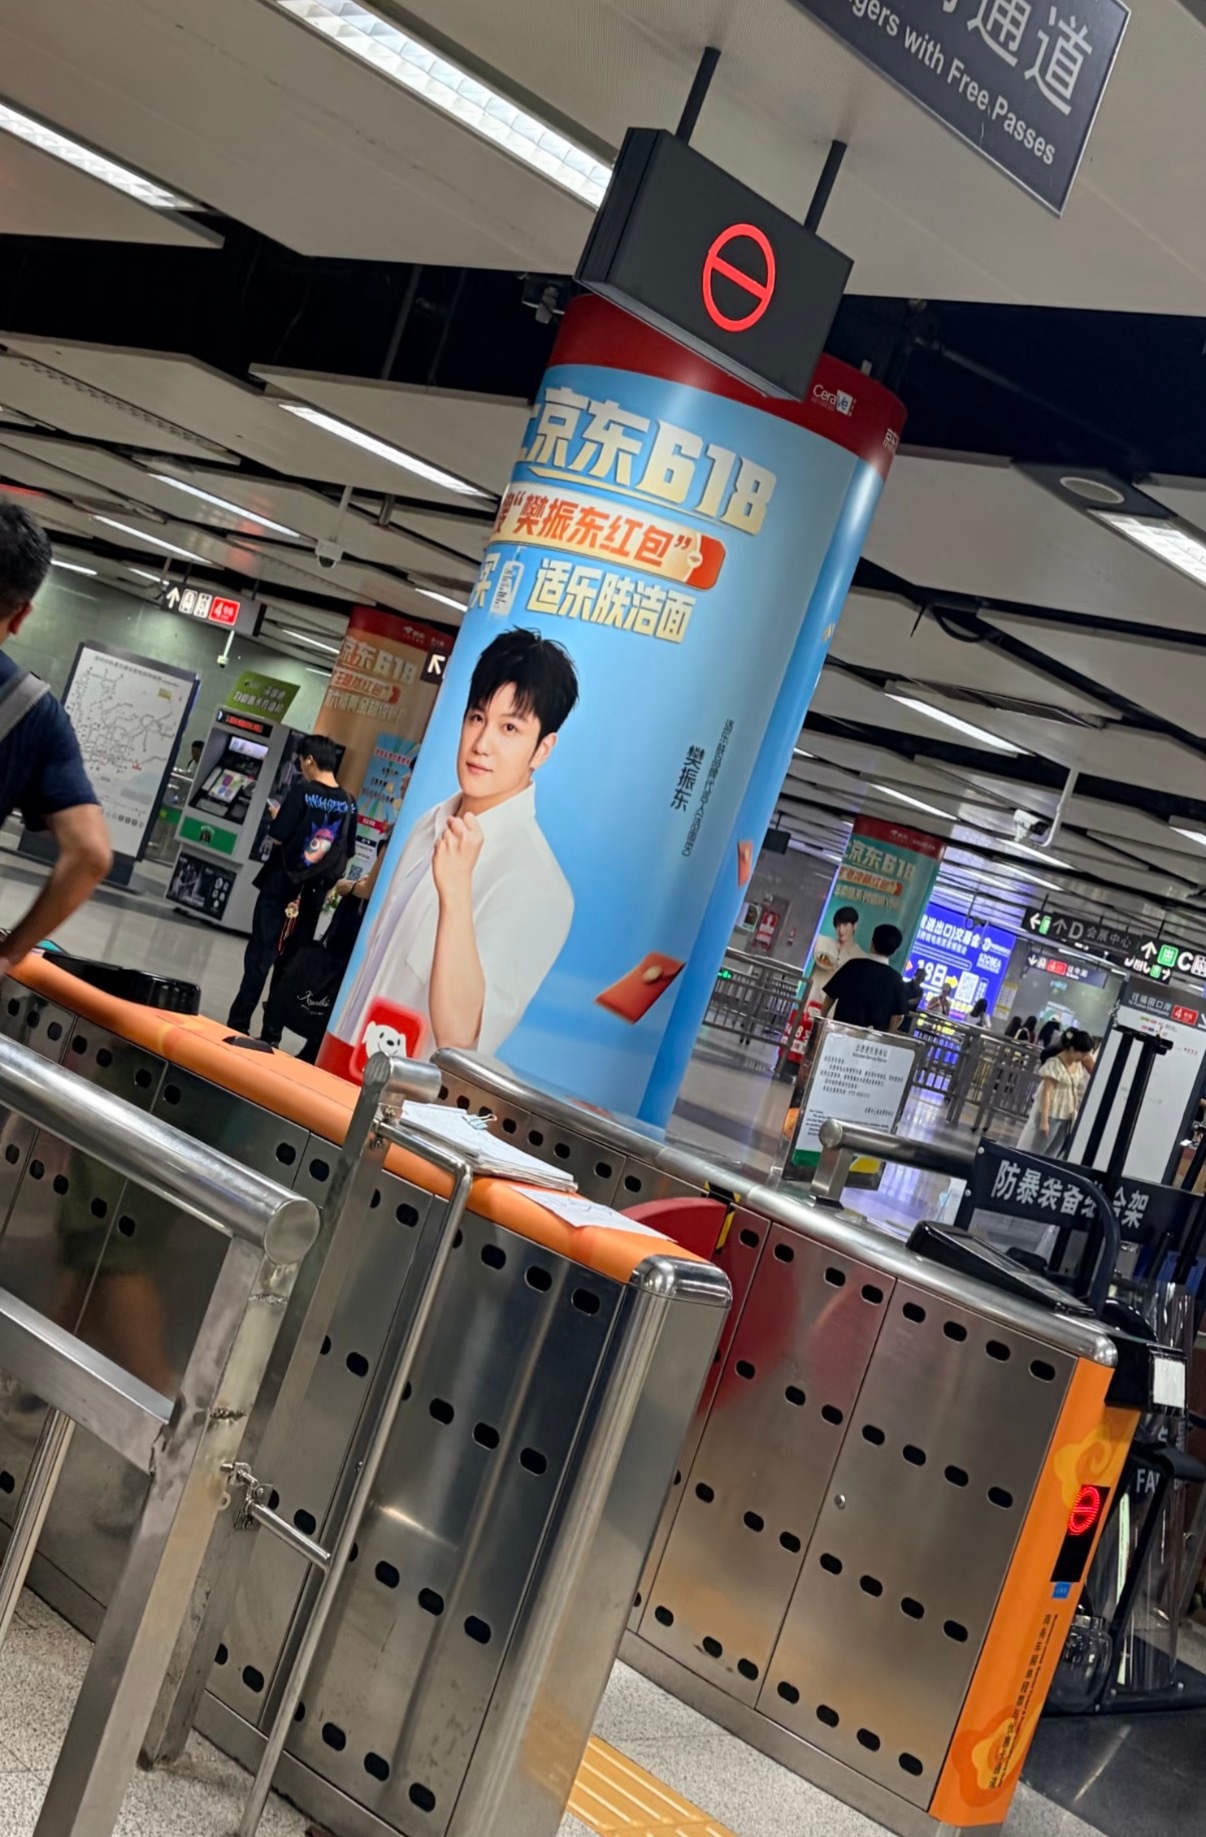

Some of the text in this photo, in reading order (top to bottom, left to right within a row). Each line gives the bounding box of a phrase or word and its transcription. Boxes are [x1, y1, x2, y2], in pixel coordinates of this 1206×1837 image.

[848, 0, 1056, 165] gers with Free Passes
[943, 0, 1093, 116] 通道
[812, 384, 852, 412] CeraVe
[521, 386, 777, 536] 京东618
[526, 557, 696, 644] 适乐肤洁面
[670, 744, 706, 813] 樊振东
[1068, 922, 1084, 940] D
[1086, 925, 1133, 949] 会展中心
[1177, 951, 1194, 971] C
